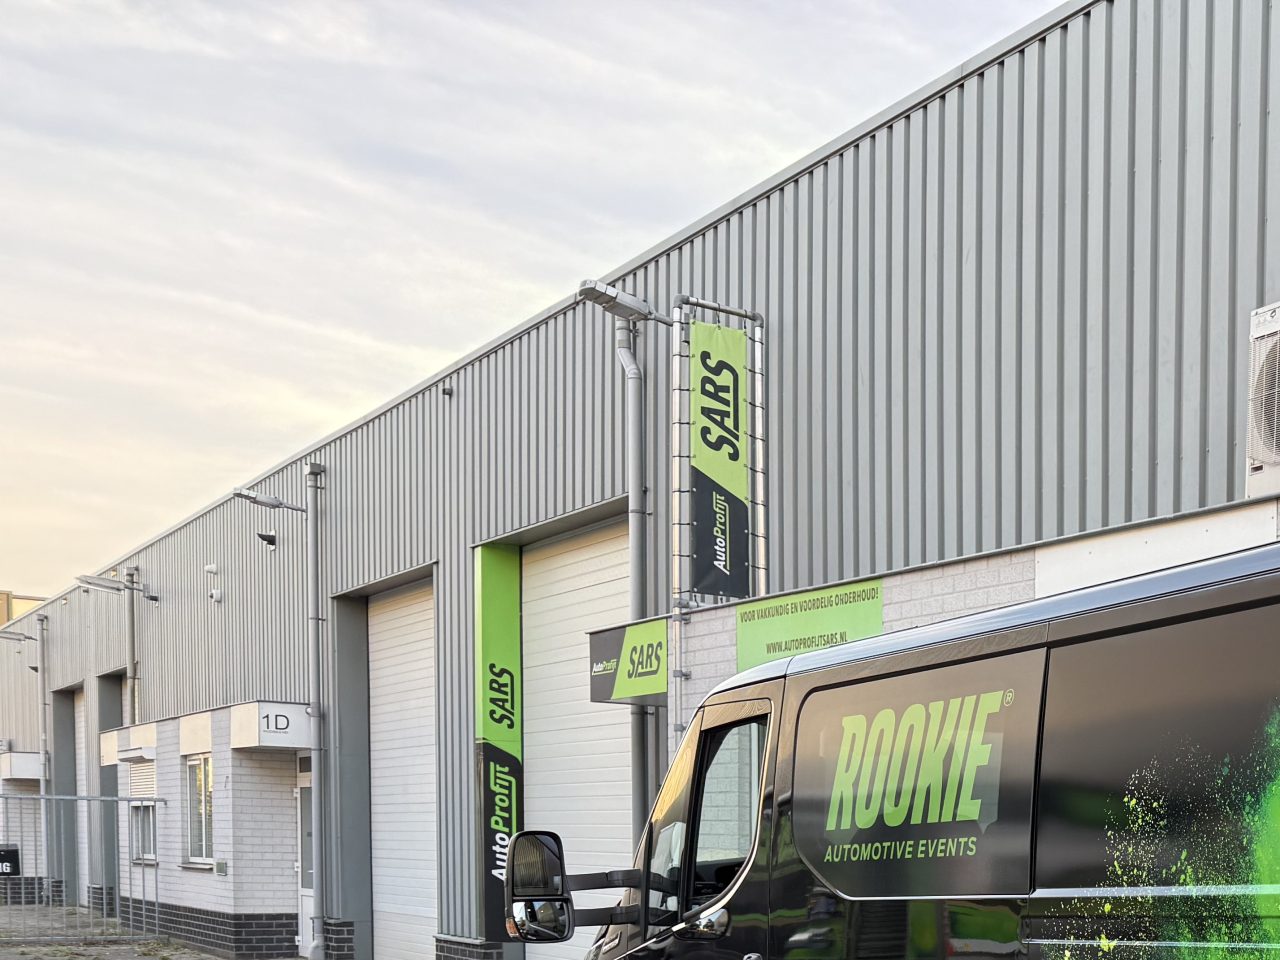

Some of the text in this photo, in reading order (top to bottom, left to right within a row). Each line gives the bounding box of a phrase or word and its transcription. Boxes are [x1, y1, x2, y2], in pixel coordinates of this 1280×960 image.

[700, 350, 740, 462] SARS
[740, 587, 879, 624] VOOR VAKKUNDIG EN VOORDELIG ONDERHOUD!
[766, 631, 848, 654] WWW.AUTOPROFIJTSARS.NL
[628, 641, 663, 679] SARS
[489, 662, 515, 729] SARS
[262, 714, 290, 730] 1D
[824, 837, 977, 863] AUTOMOTIVE EVENTS
[0, 862, 11, 873] G
